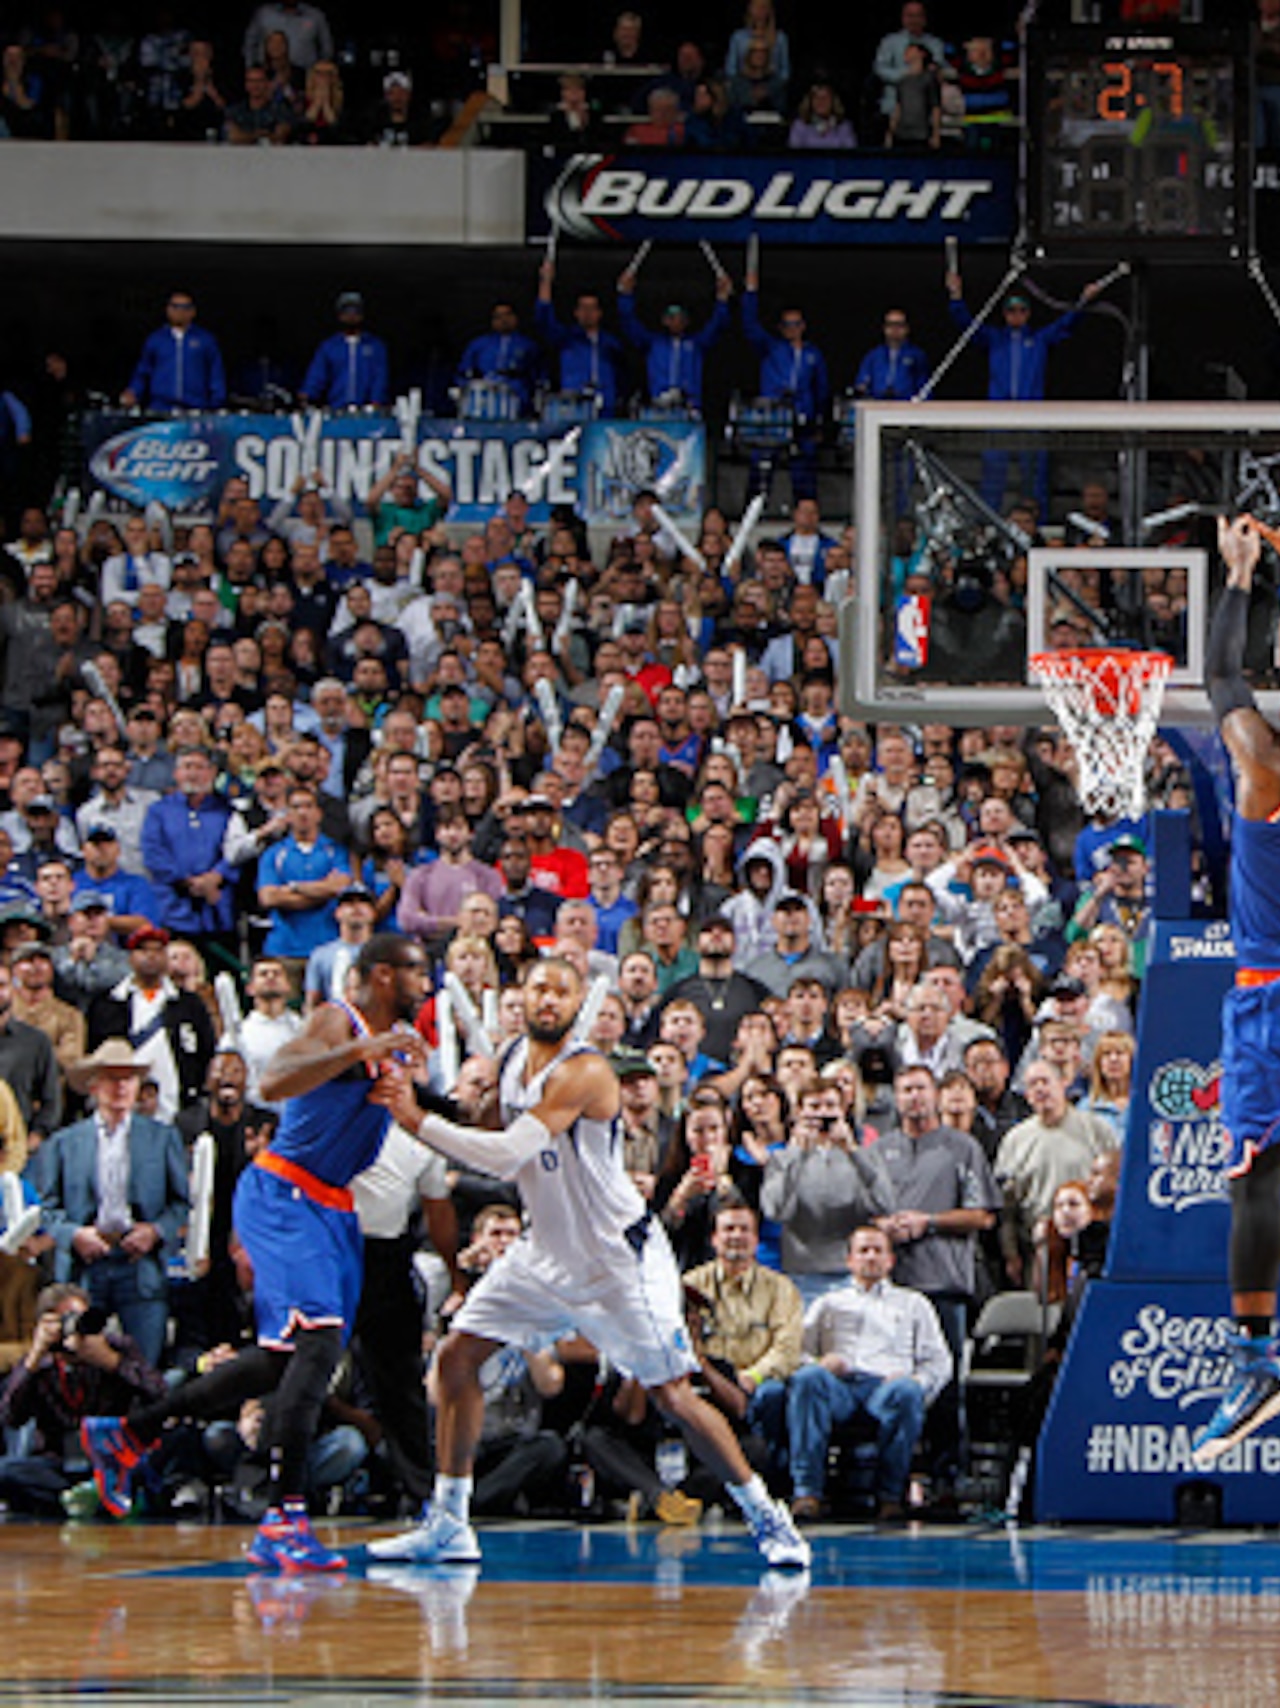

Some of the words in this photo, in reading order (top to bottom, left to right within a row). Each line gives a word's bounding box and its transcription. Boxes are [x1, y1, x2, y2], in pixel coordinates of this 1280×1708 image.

[581, 170, 754, 216] BUD
[753, 171, 993, 219] LIGHT
[127, 438, 210, 460] BUD
[113, 460, 219, 482] LIGHT
[1120, 1304, 1280, 1356] Seas
